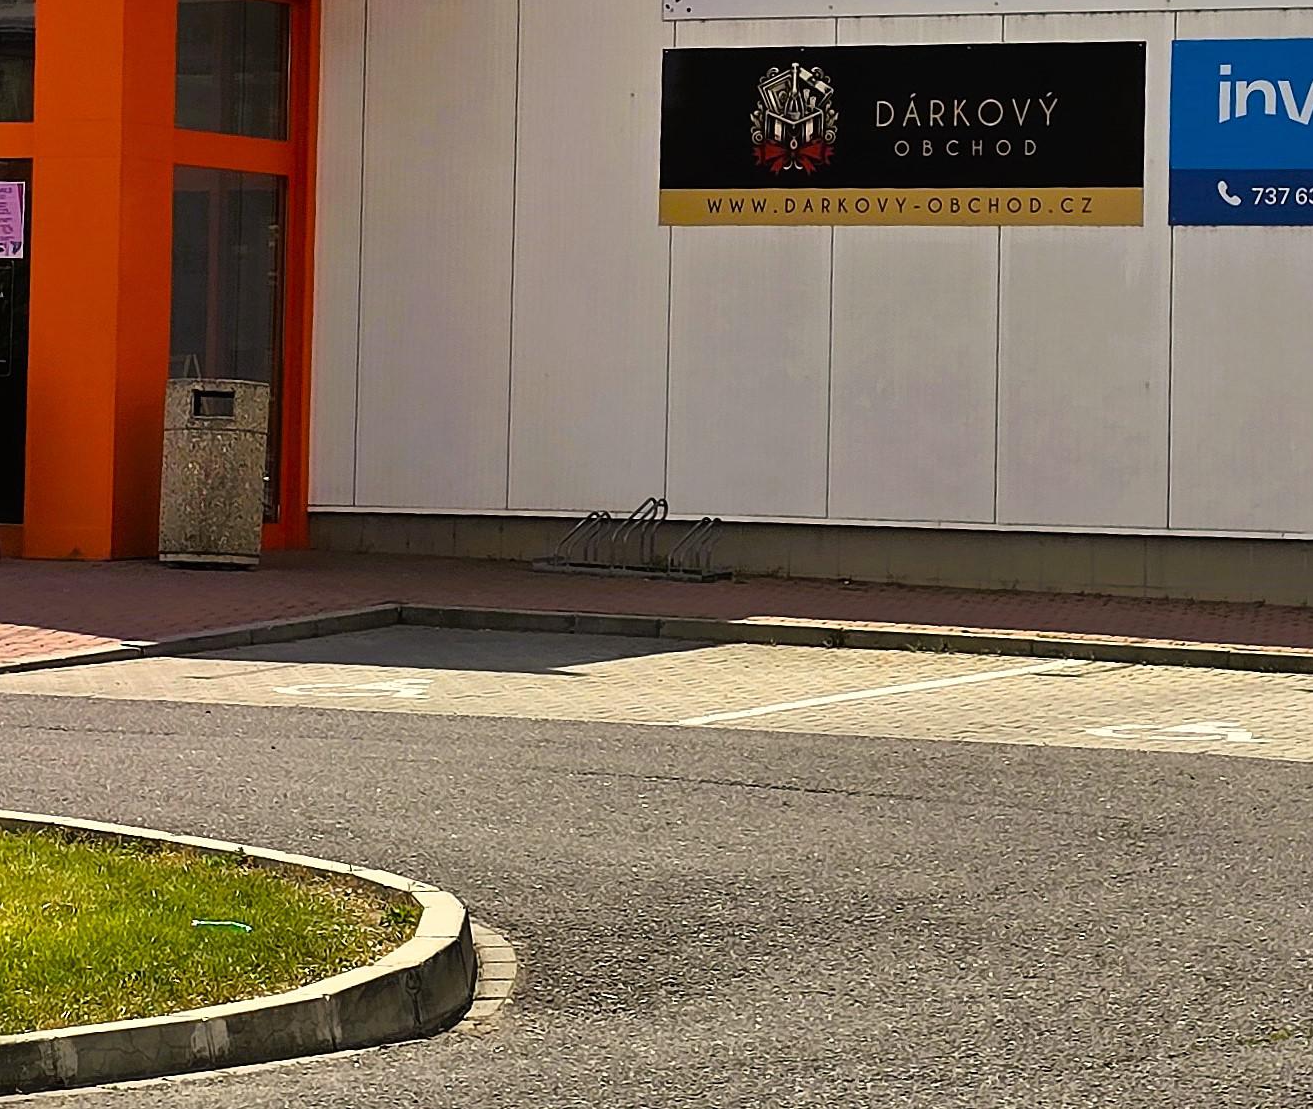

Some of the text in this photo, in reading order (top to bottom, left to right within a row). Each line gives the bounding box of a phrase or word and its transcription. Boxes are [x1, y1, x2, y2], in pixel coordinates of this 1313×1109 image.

[875, 92, 1060, 128] DÁRKOVÝ
[894, 139, 1038, 158] OBCHOD
[707, 196, 1094, 215] WWW.DARKOVY-OBCHOD.CZ
[1252, 186, 1290, 206] 737
